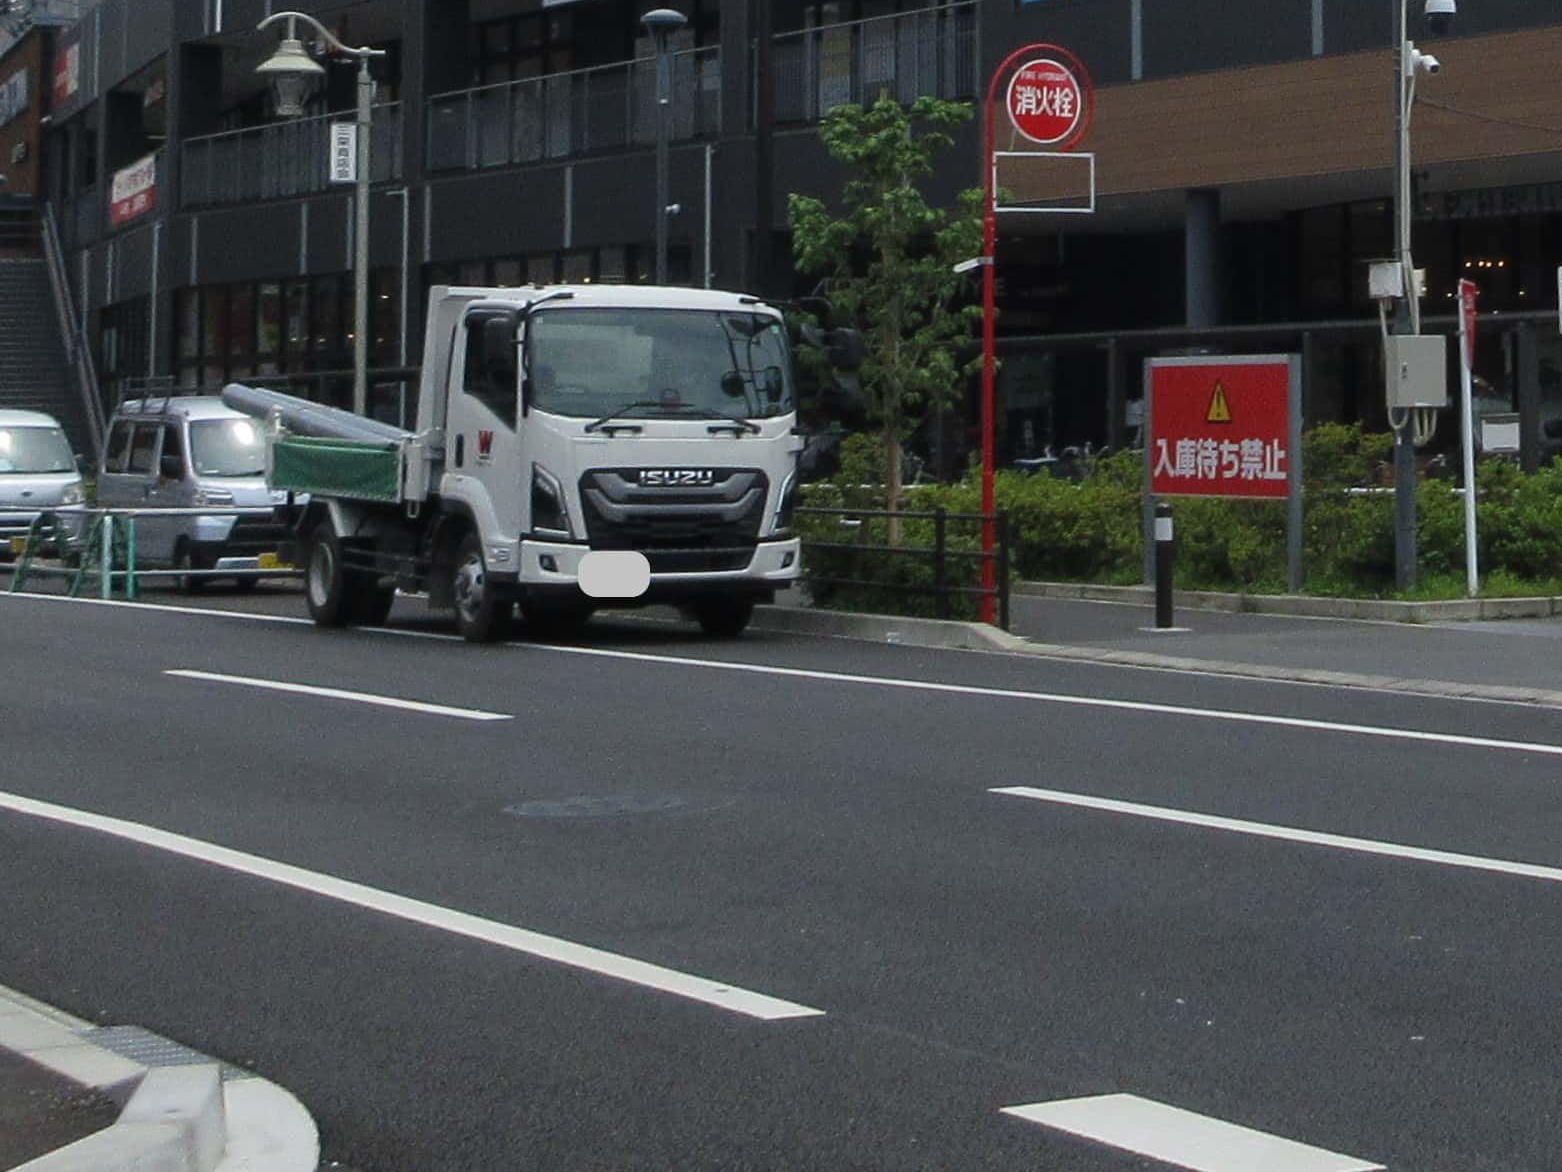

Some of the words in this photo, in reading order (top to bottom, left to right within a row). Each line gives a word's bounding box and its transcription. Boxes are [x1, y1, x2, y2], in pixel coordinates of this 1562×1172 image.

[1015, 85, 1074, 118] 消火栓
[1153, 437, 1288, 481] 入庫待ち禁止
[639, 470, 713, 485] ISUZU
